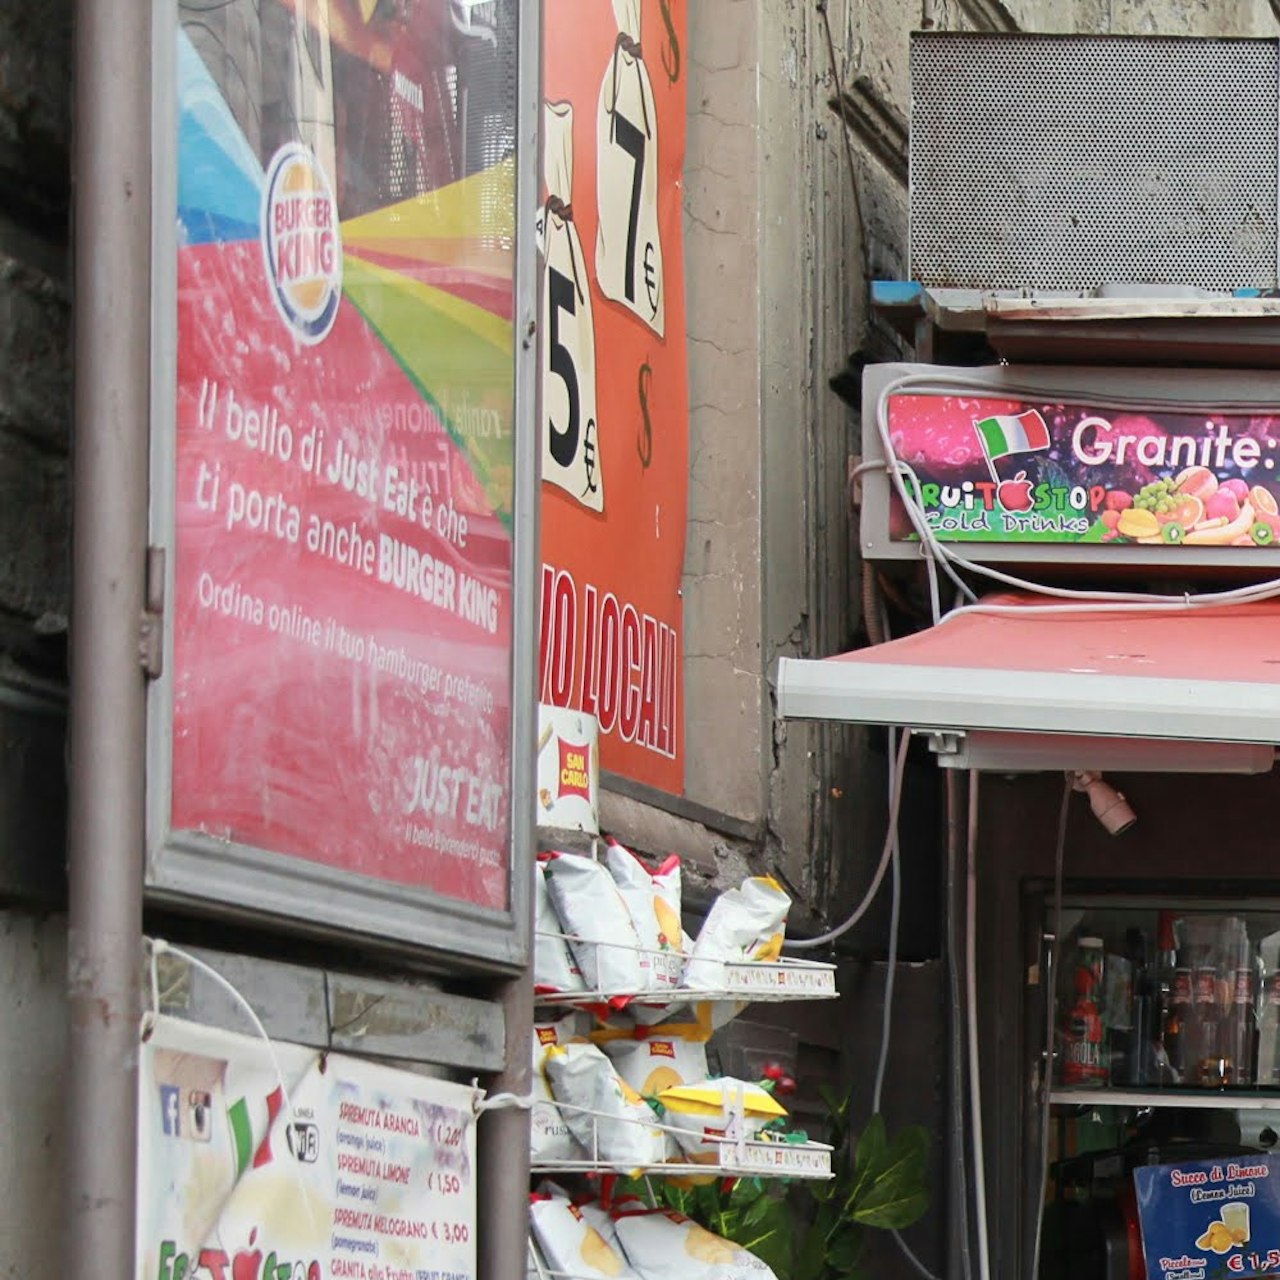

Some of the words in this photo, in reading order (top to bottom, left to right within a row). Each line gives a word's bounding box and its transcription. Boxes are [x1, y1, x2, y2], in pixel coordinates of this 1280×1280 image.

[275, 198, 331, 236] BURGER
[615, 110, 645, 303] 7
[275, 230, 333, 283] KING
[549, 266, 580, 468] 5
[1072, 414, 1276, 470] Granite:
[199, 378, 218, 430] Il
[226, 389, 293, 461] bello
[300, 427, 324, 476] di
[327, 438, 382, 502] Just
[383, 465, 418, 523] Eat
[421, 486, 432, 529] è
[437, 498, 468, 548] che
[1032, 481, 1108, 513] STOP
[925, 511, 990, 532] Cold
[1001, 514, 1089, 534] Drinks
[195, 461, 221, 512] ti
[227, 483, 300, 544] porta
[307, 514, 375, 575] anche
[378, 533, 455, 612] BURGER
[458, 572, 498, 634] KING
[199, 573, 264, 626] Ordina
[268, 604, 321, 646] online
[325, 617, 335, 649] il
[336, 627, 365, 660] tuo
[367, 635, 443, 692] hamburger
[444, 673, 495, 715] preferito
[580, 584, 677, 759] LOCALI
[561, 768, 589, 788] CARLO
[567, 753, 585, 769] SAN
[406, 752, 468, 819] JUST
[466, 778, 503, 832] EAT
[339, 1101, 381, 1129] SPREMUTA
[383, 1109, 420, 1138] ARANCIA
[337, 1153, 382, 1179] SPREMUTA
[383, 1162, 411, 1185] LIMONE
[437, 1173, 460, 1194] 1,50
[1171, 1170, 1207, 1187] Succo
[1210, 1166, 1223, 1181] di
[1226, 1163, 1269, 1180] Limone
[1227, 1183, 1255, 1198] Juice)
[333, 1207, 373, 1231] SPREMUTA
[374, 1213, 428, 1239] MELOGRANO
[444, 1222, 469, 1244] 3,00
[331, 1259, 367, 1280] GRANITA
[1227, 1254, 1243, 1272] €
